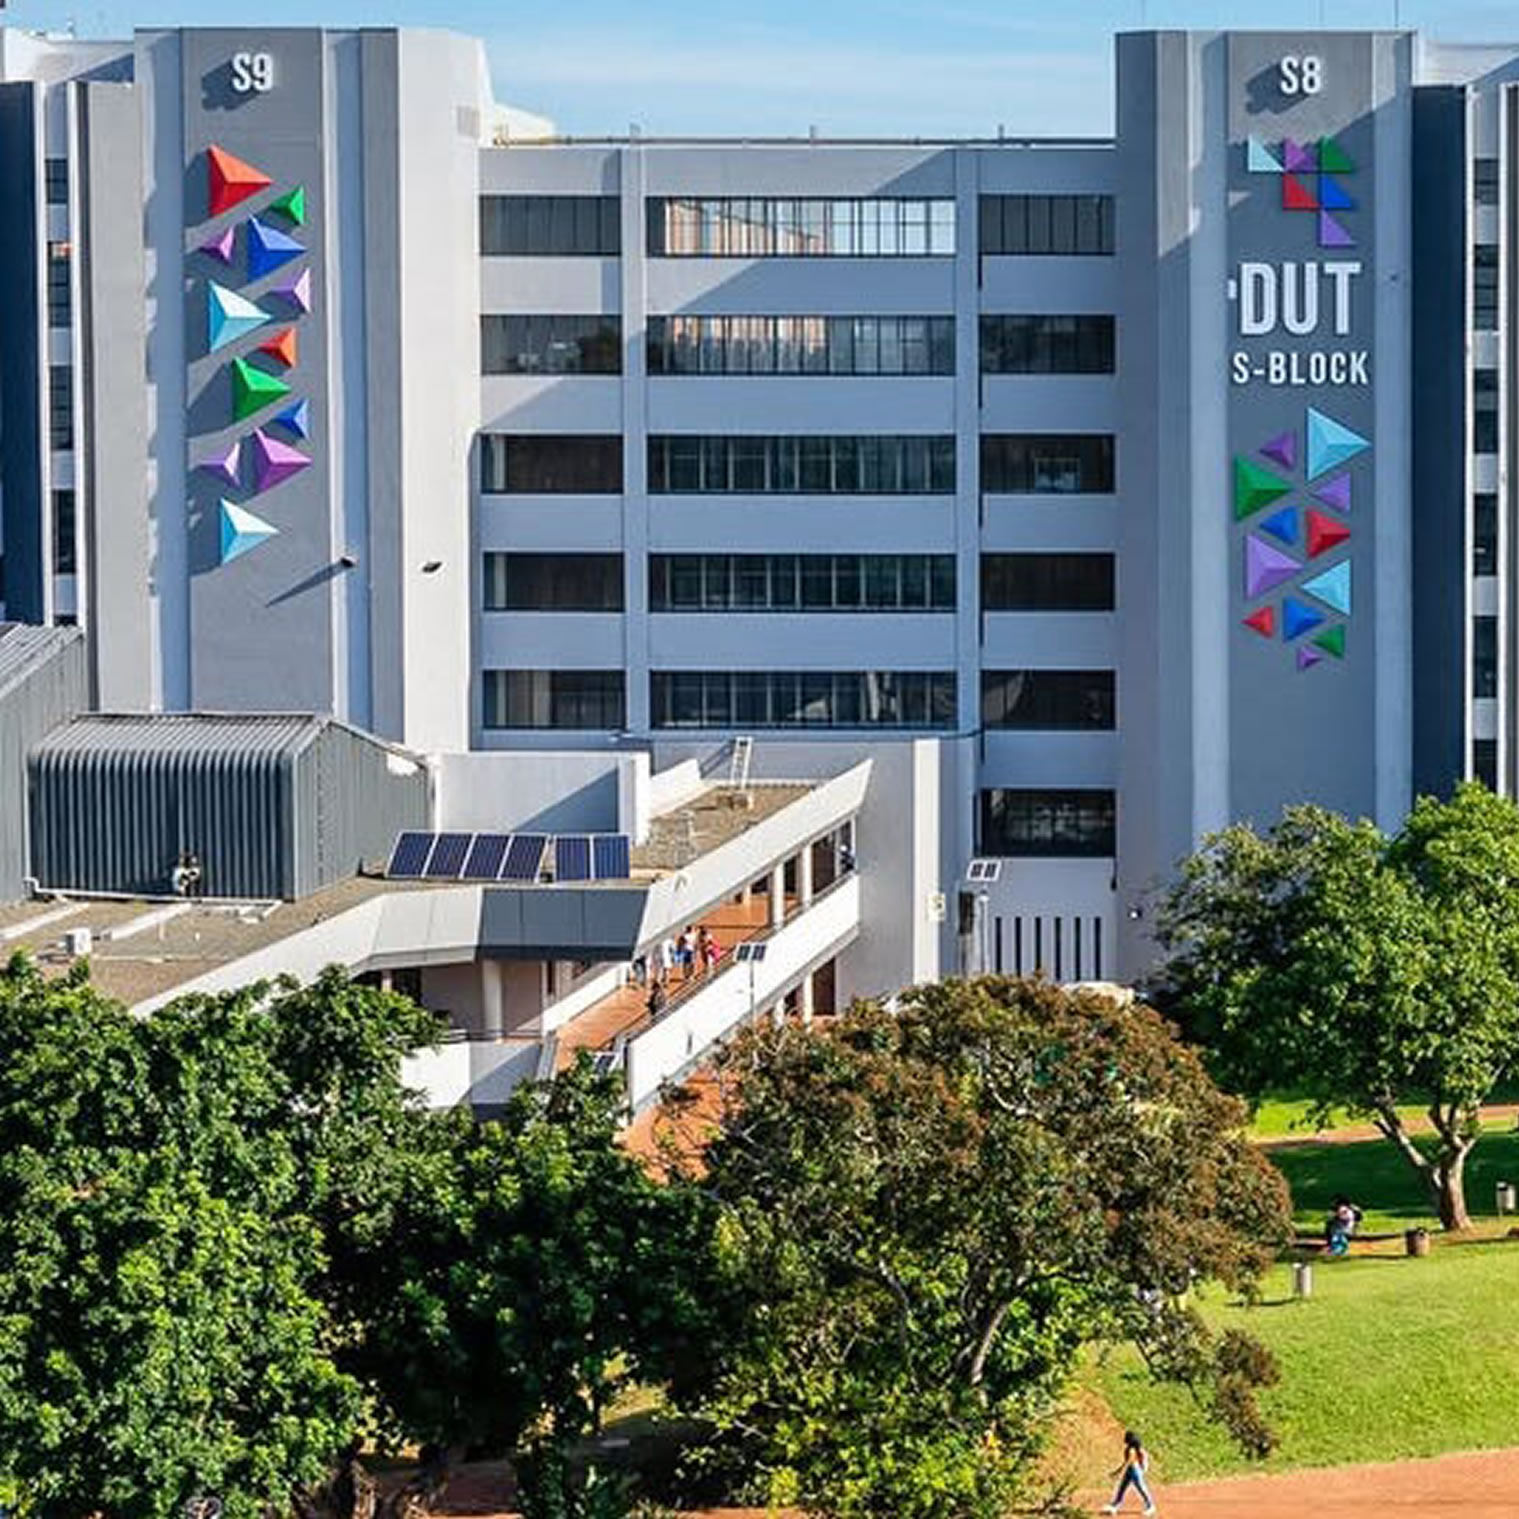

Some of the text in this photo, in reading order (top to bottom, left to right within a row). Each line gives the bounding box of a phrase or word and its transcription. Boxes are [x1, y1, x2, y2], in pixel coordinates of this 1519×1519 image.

[232, 52, 273, 91] S9
[1281, 56, 1321, 94] S8
[1240, 262, 1362, 335] DUT
[1233, 351, 1369, 384] S-BLOCK
